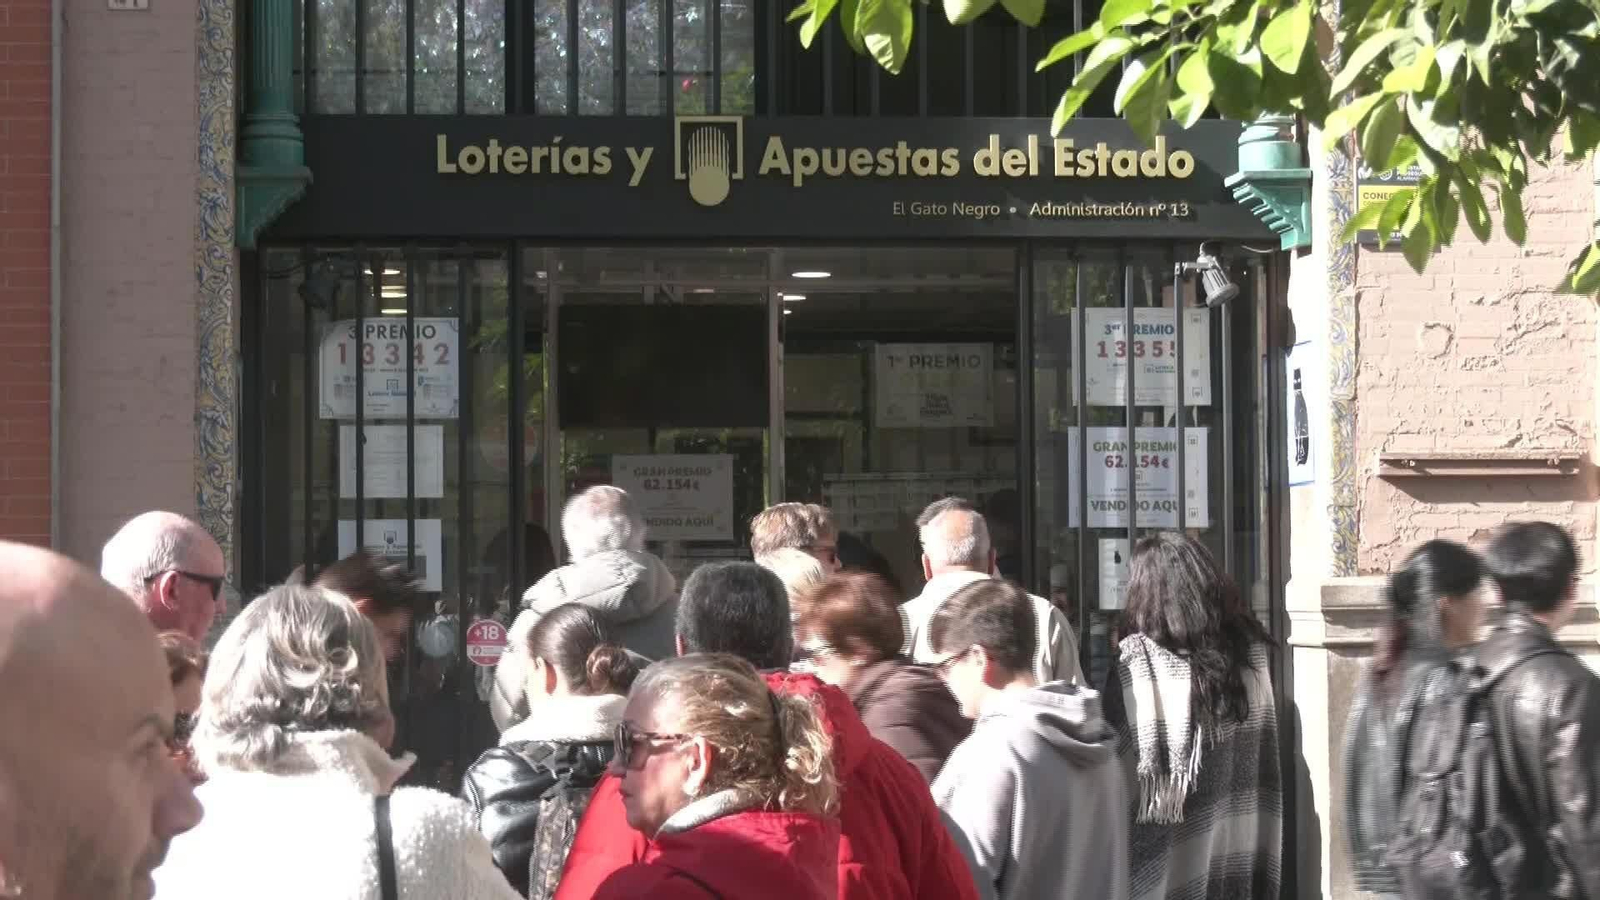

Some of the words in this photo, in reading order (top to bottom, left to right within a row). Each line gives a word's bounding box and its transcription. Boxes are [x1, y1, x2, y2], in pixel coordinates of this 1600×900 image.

[436, 133, 612, 175] Loterías
[625, 146, 654, 186] y
[759, 136, 960, 187] Apuestas
[973, 134, 1038, 178] del
[1054, 135, 1195, 178] Estado
[893, 202, 904, 217] El
[910, 202, 947, 217] Gato
[952, 202, 1000, 220] Negro
[1030, 202, 1144, 217] Administración
[1170, 202, 1189, 217] 13
[366, 324, 436, 340] PREMIO
[1124, 324, 1175, 335] REMIO
[909, 353, 981, 369] PREMIO
[1093, 441, 1127, 452] GRAN
[1105, 455, 1169, 469] 62.154€
[1091, 500, 1149, 512] VENDDO
[1152, 500, 1178, 514] AQU
[645, 516, 681, 527] NDIDO
[474, 625, 499, 640] +18
